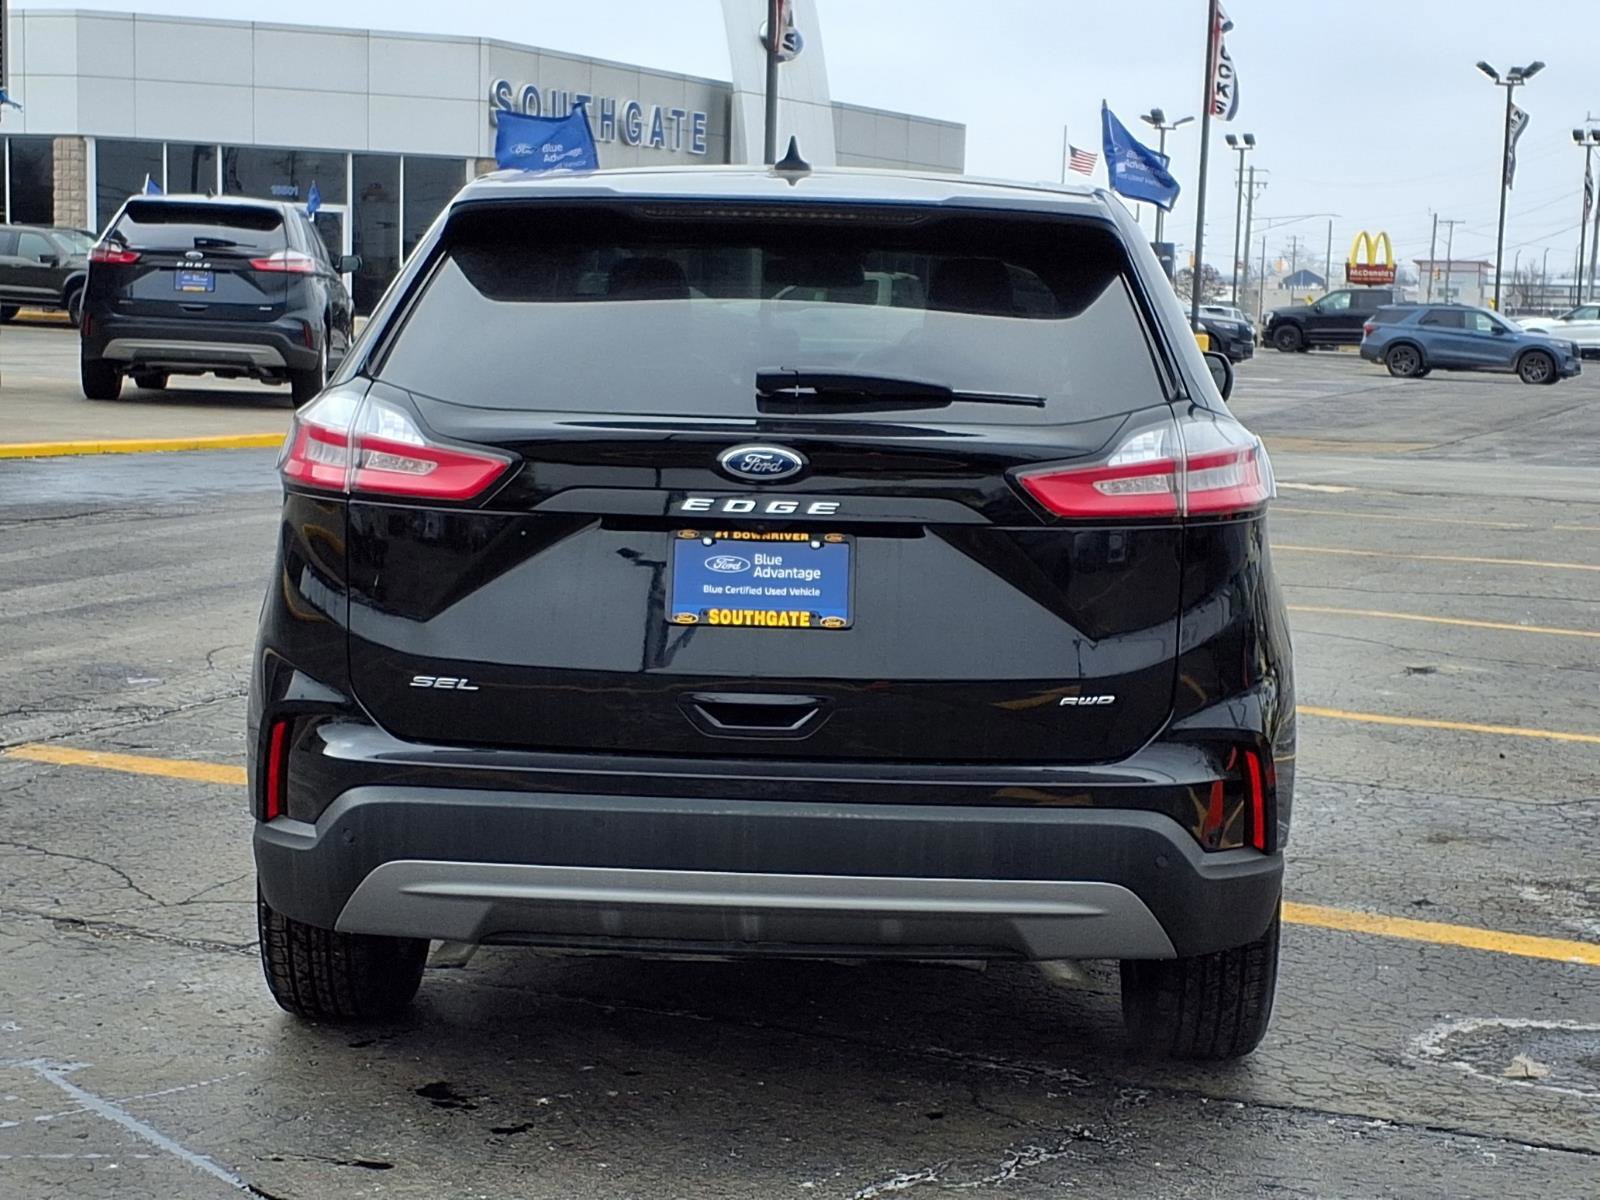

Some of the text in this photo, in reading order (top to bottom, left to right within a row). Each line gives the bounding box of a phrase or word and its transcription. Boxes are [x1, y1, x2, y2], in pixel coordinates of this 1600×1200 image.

[1350, 269, 1394, 277] McDonald's
[741, 453, 784, 473] Ford
[681, 498, 841, 515] EDGE
[714, 531, 810, 541] #1 DOWNRIVER
[713, 558, 742, 570] Ford
[754, 553, 783, 566] Blue
[753, 566, 821, 581] Advantage
[703, 585, 821, 597] Blue Certified Used Vehicle
[708, 607, 811, 627] SOUTHGATE
[409, 675, 480, 690] SEL
[1059, 695, 1116, 706] AWD
